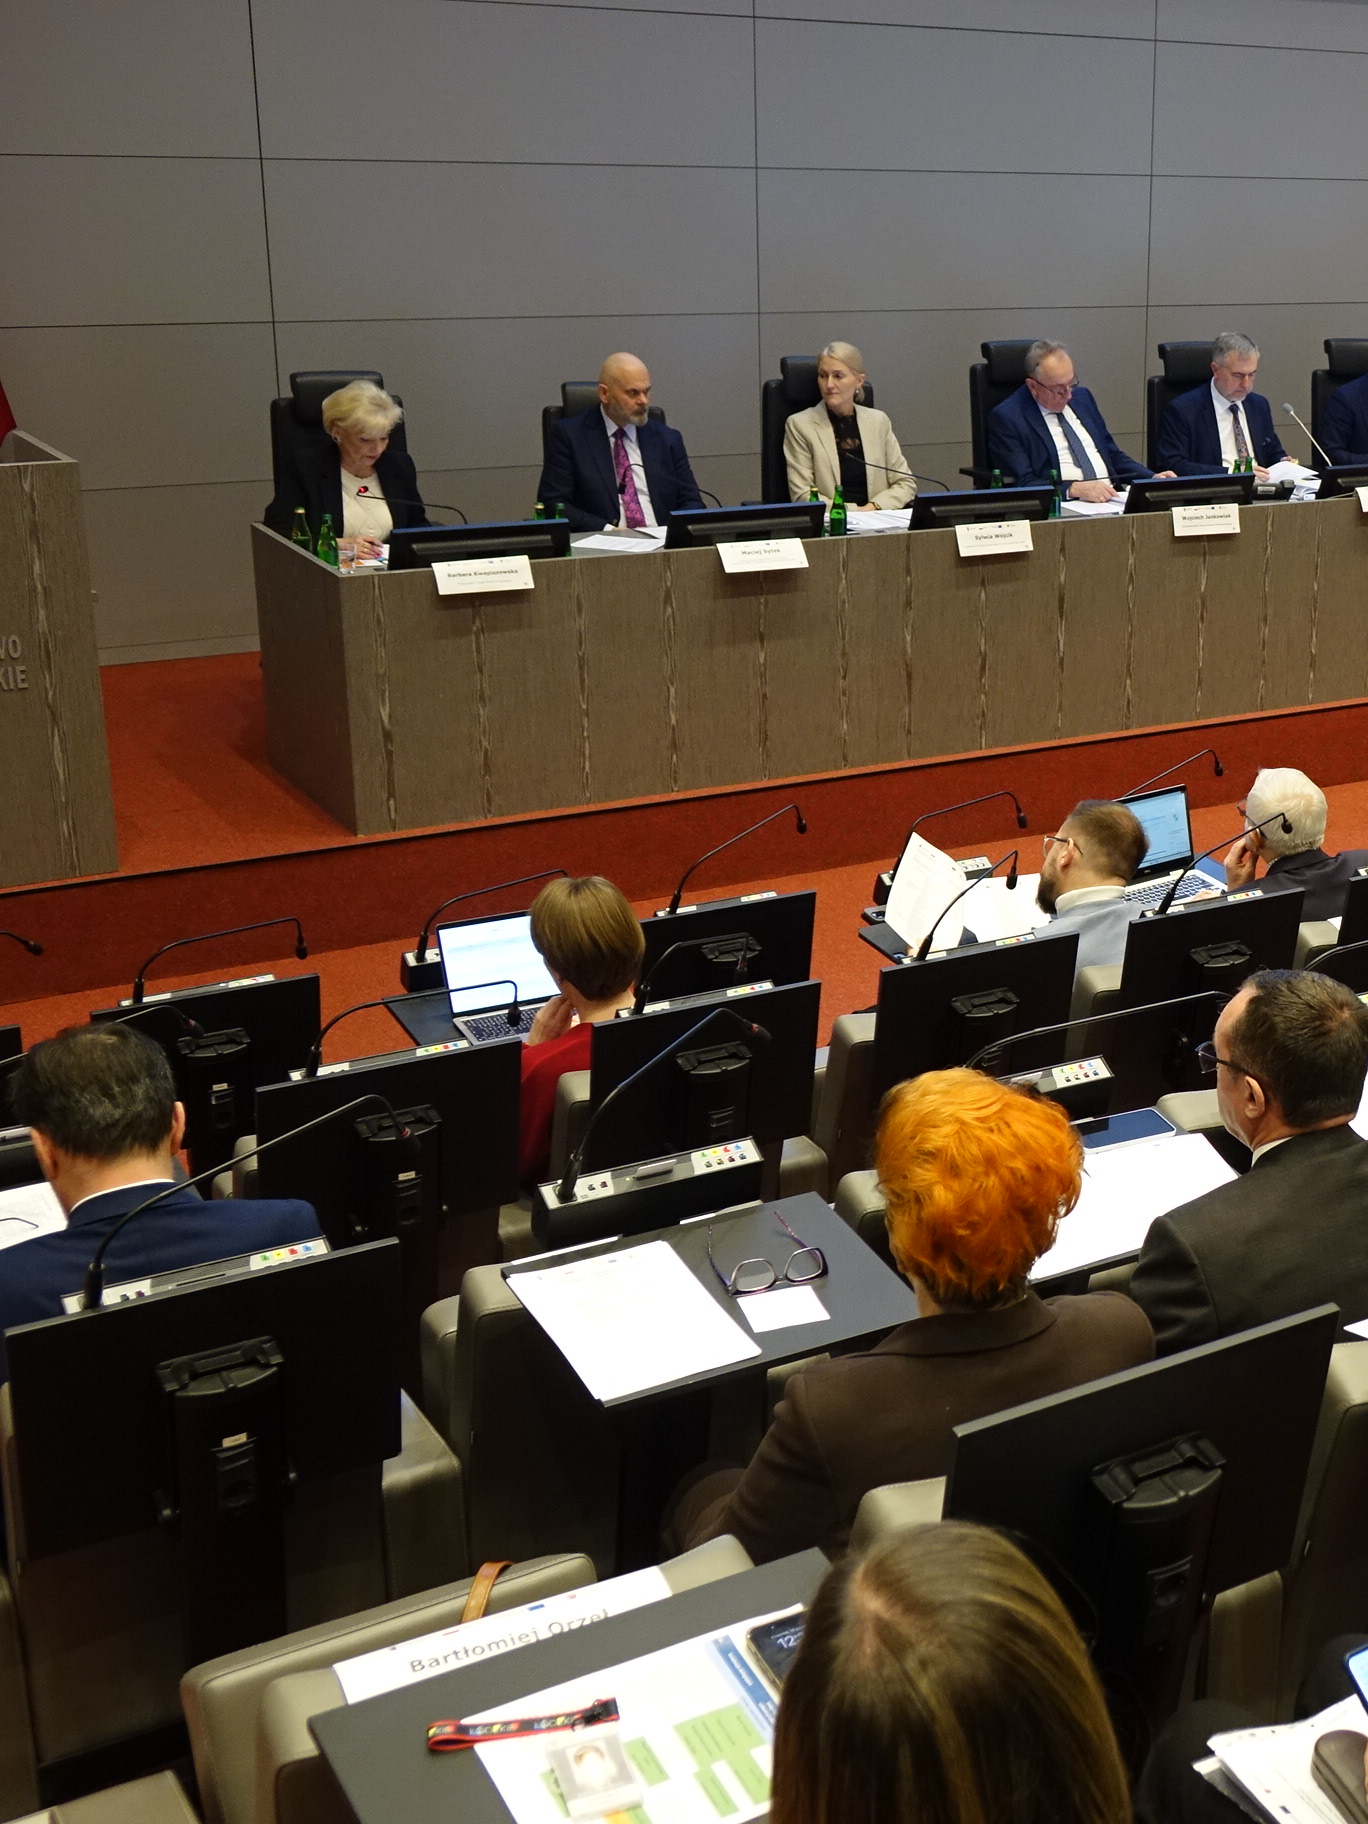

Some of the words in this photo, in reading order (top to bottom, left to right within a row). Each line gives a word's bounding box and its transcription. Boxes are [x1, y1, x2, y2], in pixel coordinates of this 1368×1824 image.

[1181, 514, 1205, 522] Wojciech
[447, 571, 473, 579] Barbara
[410, 1628, 540, 1673] Bartłomiej
